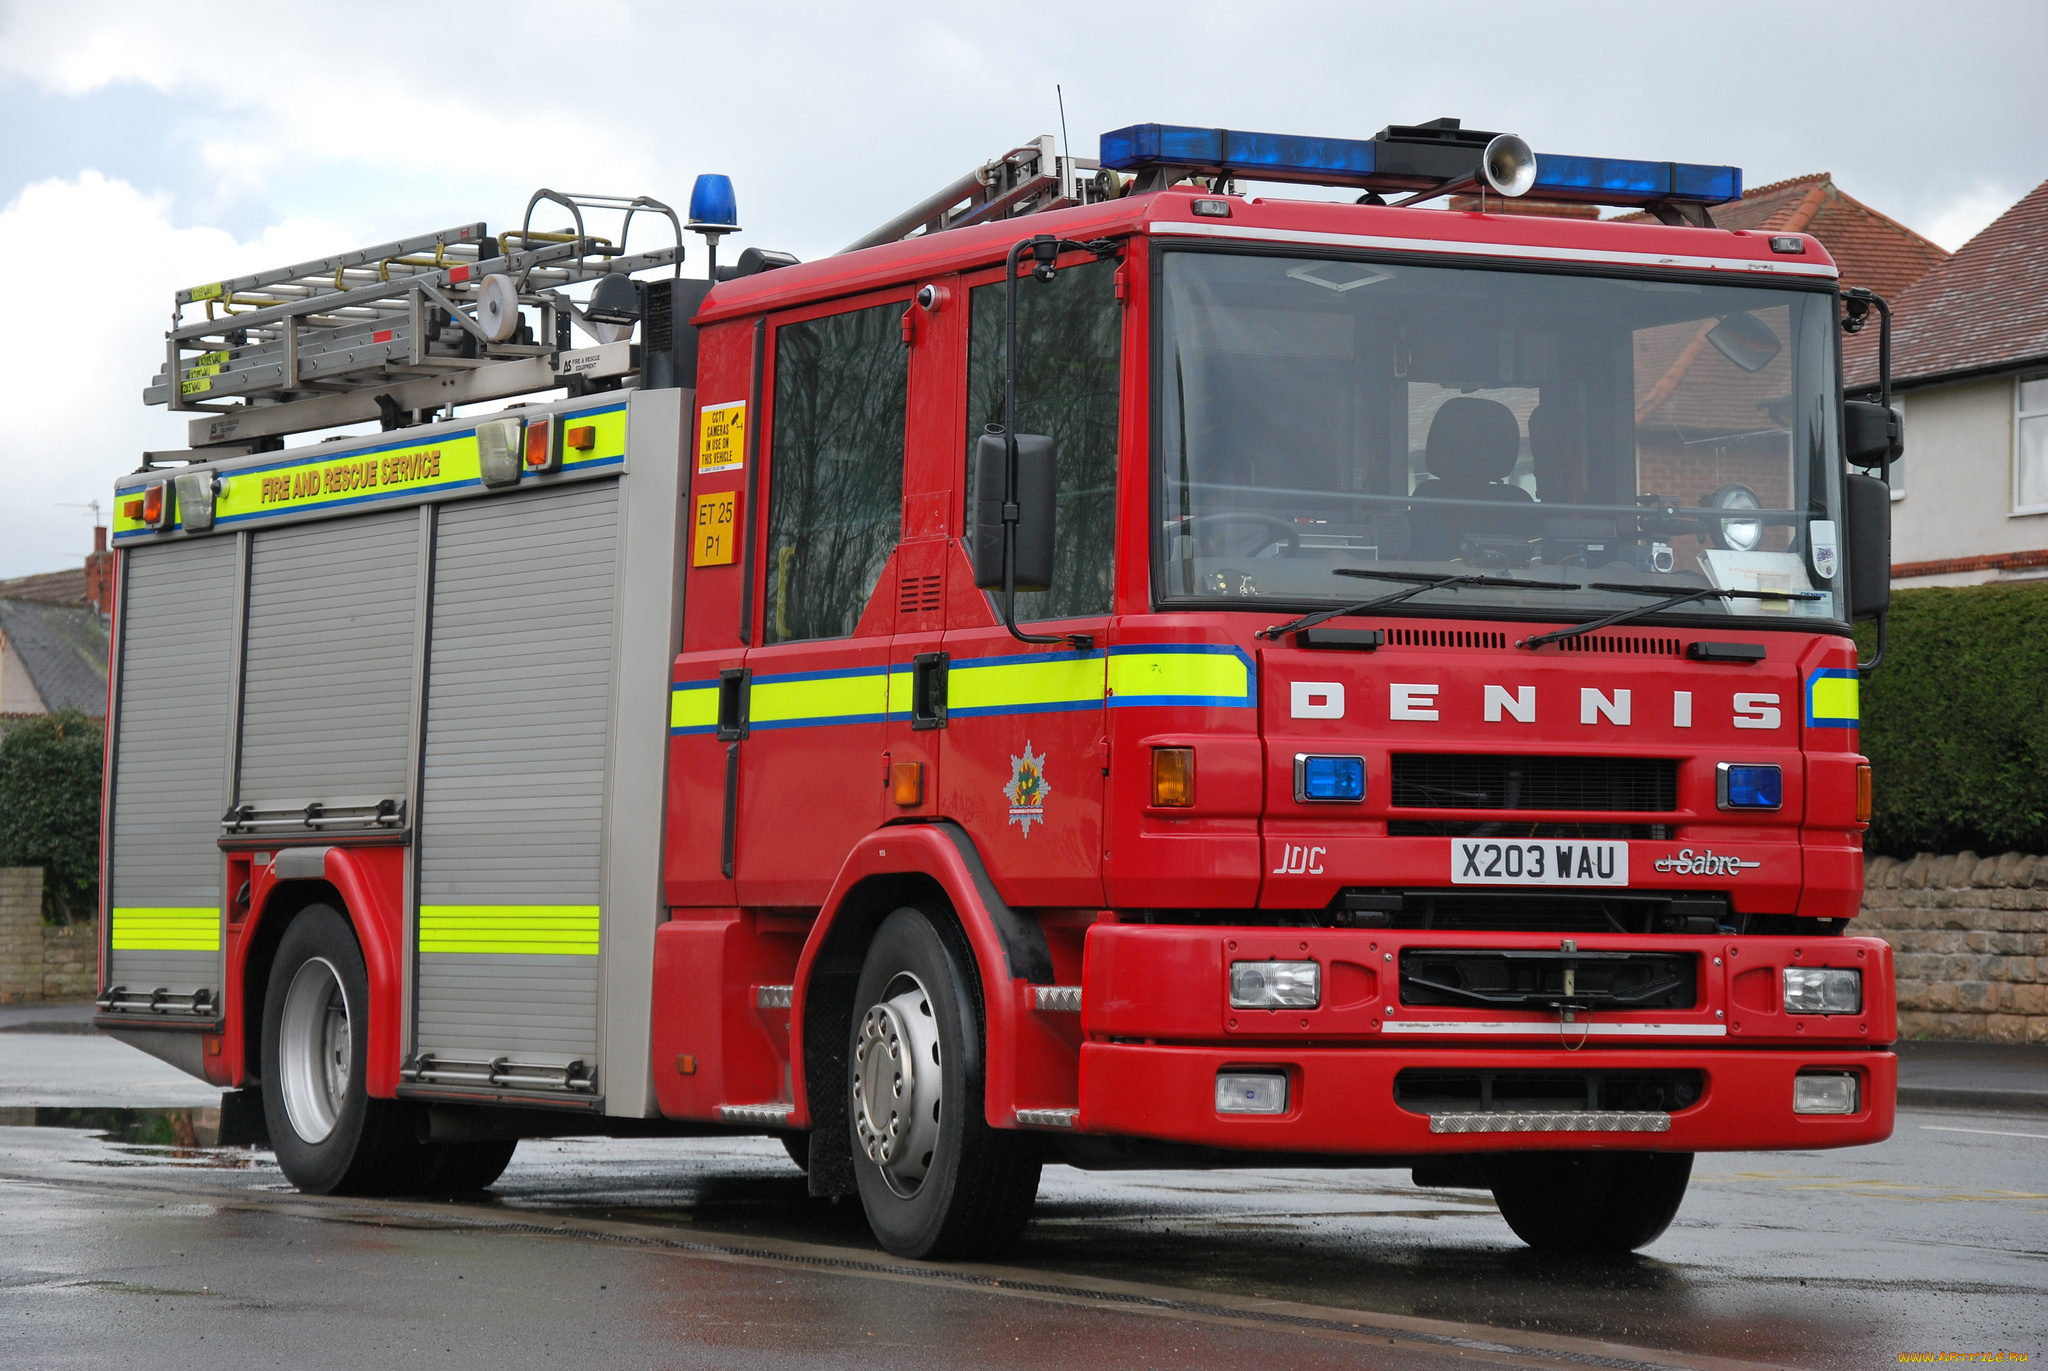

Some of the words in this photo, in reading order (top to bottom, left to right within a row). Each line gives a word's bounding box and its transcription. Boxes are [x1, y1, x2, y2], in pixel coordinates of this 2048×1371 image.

[575, 362, 597, 372] EQUIPMENT
[585, 354, 600, 363] RESCUE
[712, 410, 725, 424] CCTV
[706, 423, 730, 438] CAMERAS
[705, 440, 711, 451] IN
[712, 438, 721, 450] USE
[721, 437, 729, 449] ON
[701, 453, 712, 466] THIS
[713, 450, 733, 463] VEHICLE
[261, 474, 290, 503] FIRE
[292, 470, 320, 499] AND
[323, 460, 378, 494] RESCUE
[381, 450, 441, 485] SERVICE
[699, 503, 716, 526] ET
[717, 501, 733, 524] 25
[705, 534, 721, 557] P1
[1289, 681, 1782, 730] DENNIS
[1462, 843, 1546, 878] X203
[1555, 845, 1615, 879] WAU
[1675, 847, 1741, 876] Sabre
